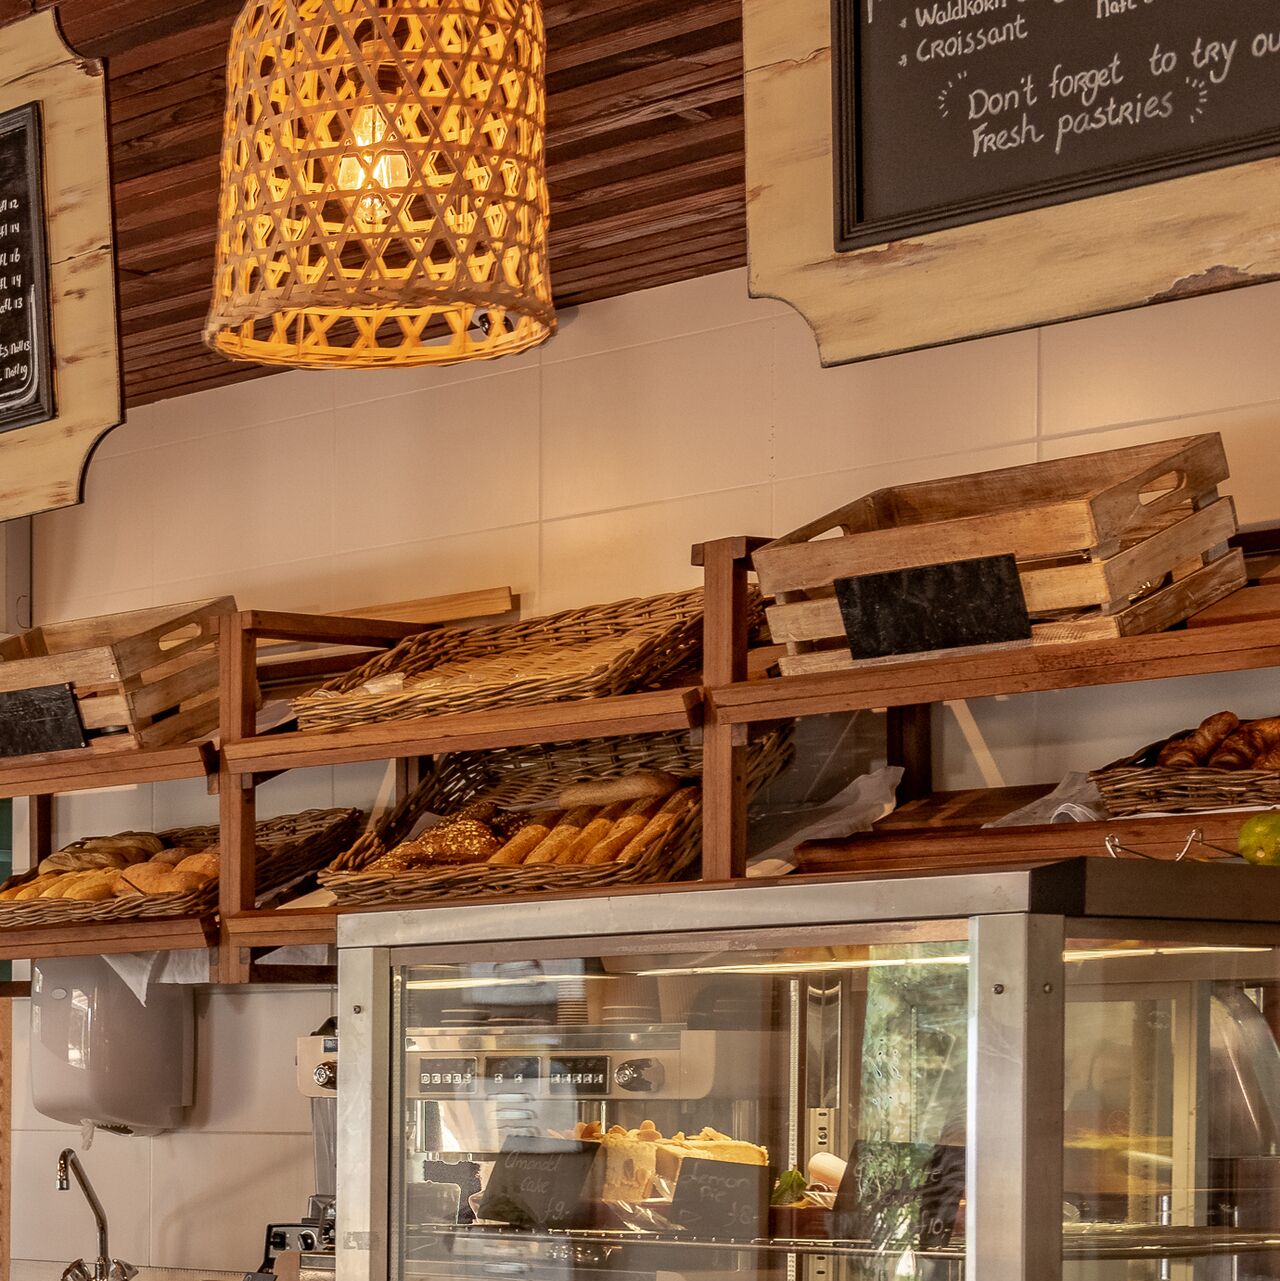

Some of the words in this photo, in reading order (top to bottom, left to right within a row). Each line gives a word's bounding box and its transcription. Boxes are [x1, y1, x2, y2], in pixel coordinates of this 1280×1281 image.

[916, 14, 1028, 62] Croissant
[968, 74, 1038, 120] Don't
[1048, 53, 1124, 107] forget
[1149, 43, 1178, 76] to
[1191, 37, 1238, 84] try
[972, 113, 1045, 158] Fresh
[1055, 91, 1173, 155] pastries
